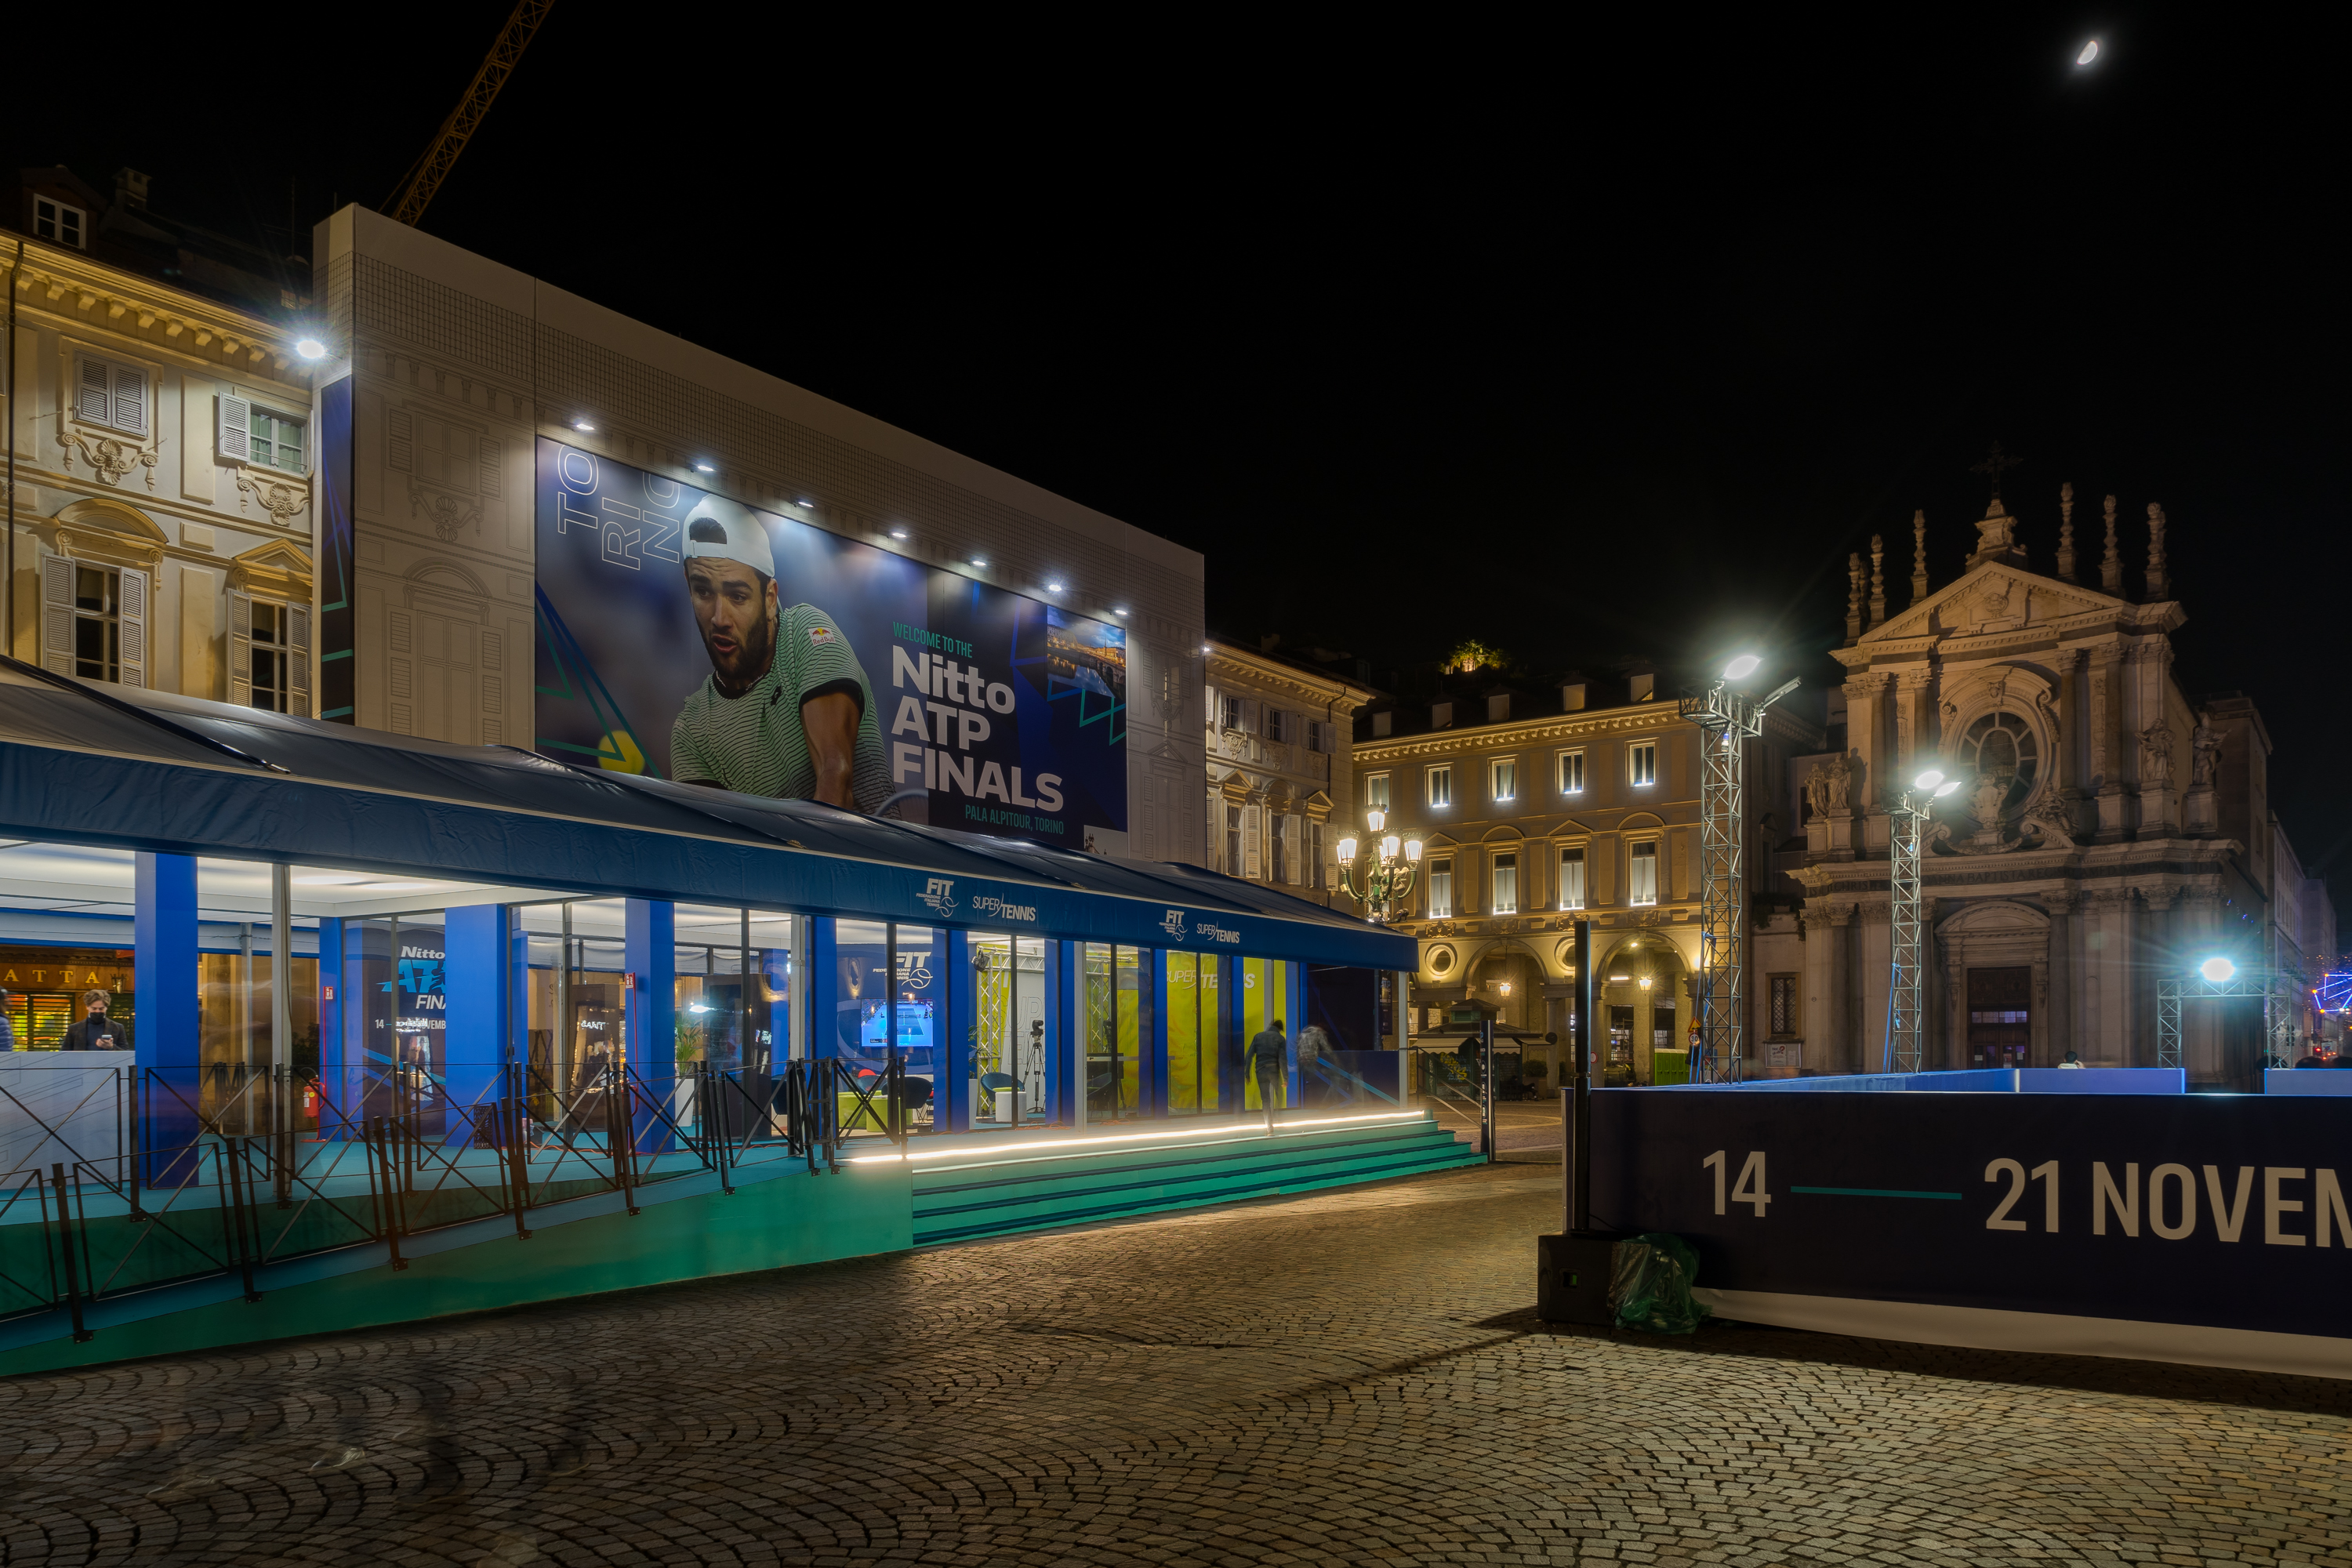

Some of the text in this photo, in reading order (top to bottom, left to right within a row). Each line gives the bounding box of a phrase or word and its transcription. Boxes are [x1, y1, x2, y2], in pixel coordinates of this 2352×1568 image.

[812, 637, 824, 645] Red
[893, 621, 973, 658] WELCOME TO THE
[892, 644, 1015, 714] Nitto
[891, 695, 991, 750] ATP
[893, 740, 1064, 812] FINALS
[965, 804, 1065, 835] PALA ALPITOUR, TORINO
[927, 877, 954, 896] FIT
[1165, 909, 1185, 924] FIT
[401, 946, 445, 960] Nitto
[376, 959, 446, 993] AT
[416, 994, 446, 1010] FIN
[375, 1018, 385, 1029] 14
[1690, 1032, 1698, 1042] 30
[1703, 1149, 1772, 1218] 14
[1984, 1157, 2060, 1233] 21
